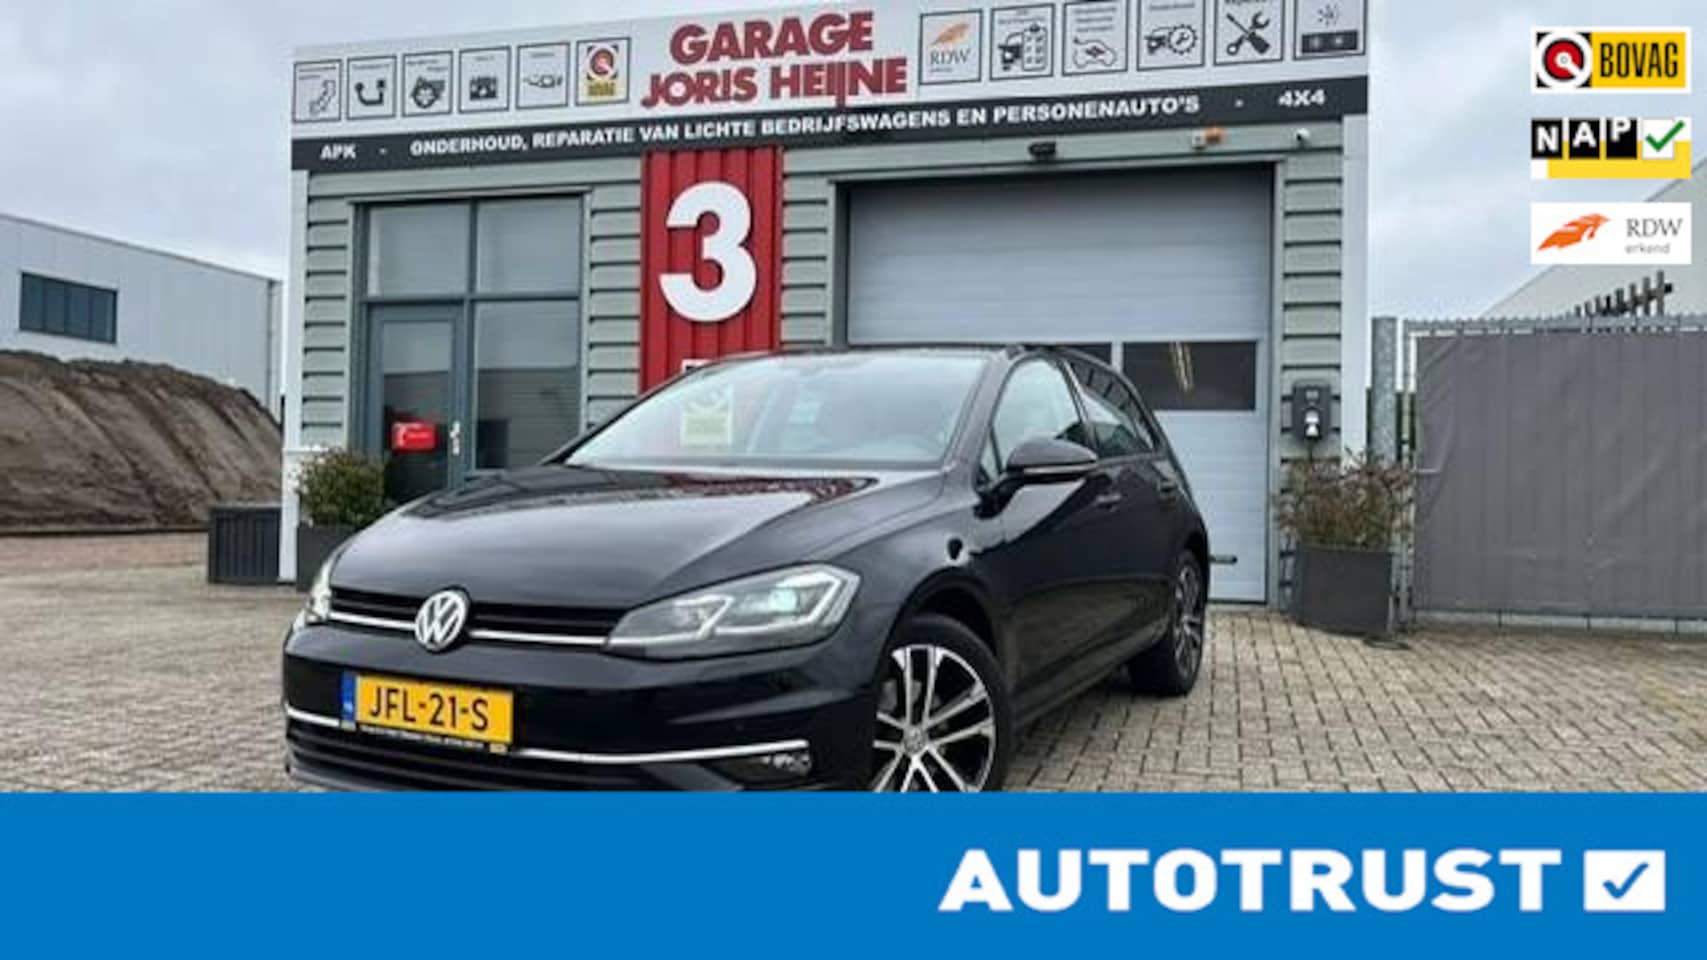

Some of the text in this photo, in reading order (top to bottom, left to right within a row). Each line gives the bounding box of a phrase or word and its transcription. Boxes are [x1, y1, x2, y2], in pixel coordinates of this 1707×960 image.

[670, 11, 874, 65] GARAGE
[930, 49, 971, 65] RDW
[641, 58, 907, 109] JORIS HEIJNE
[320, 143, 357, 160] APK
[410, 132, 528, 156] ONDERHOUD,
[533, 126, 634, 149] REPARATIE
[639, 124, 679, 142] VAN
[685, 119, 755, 139] LICHTE
[761, 109, 950, 135] BEDRIJFSWAGENS
[956, 108, 987, 126] EN
[993, 96, 1200, 124] PERSONENAUTO'S
[1278, 89, 1326, 107] 4X4
[658, 181, 757, 322] 3
[370, 686, 489, 731] JFL-21-S
